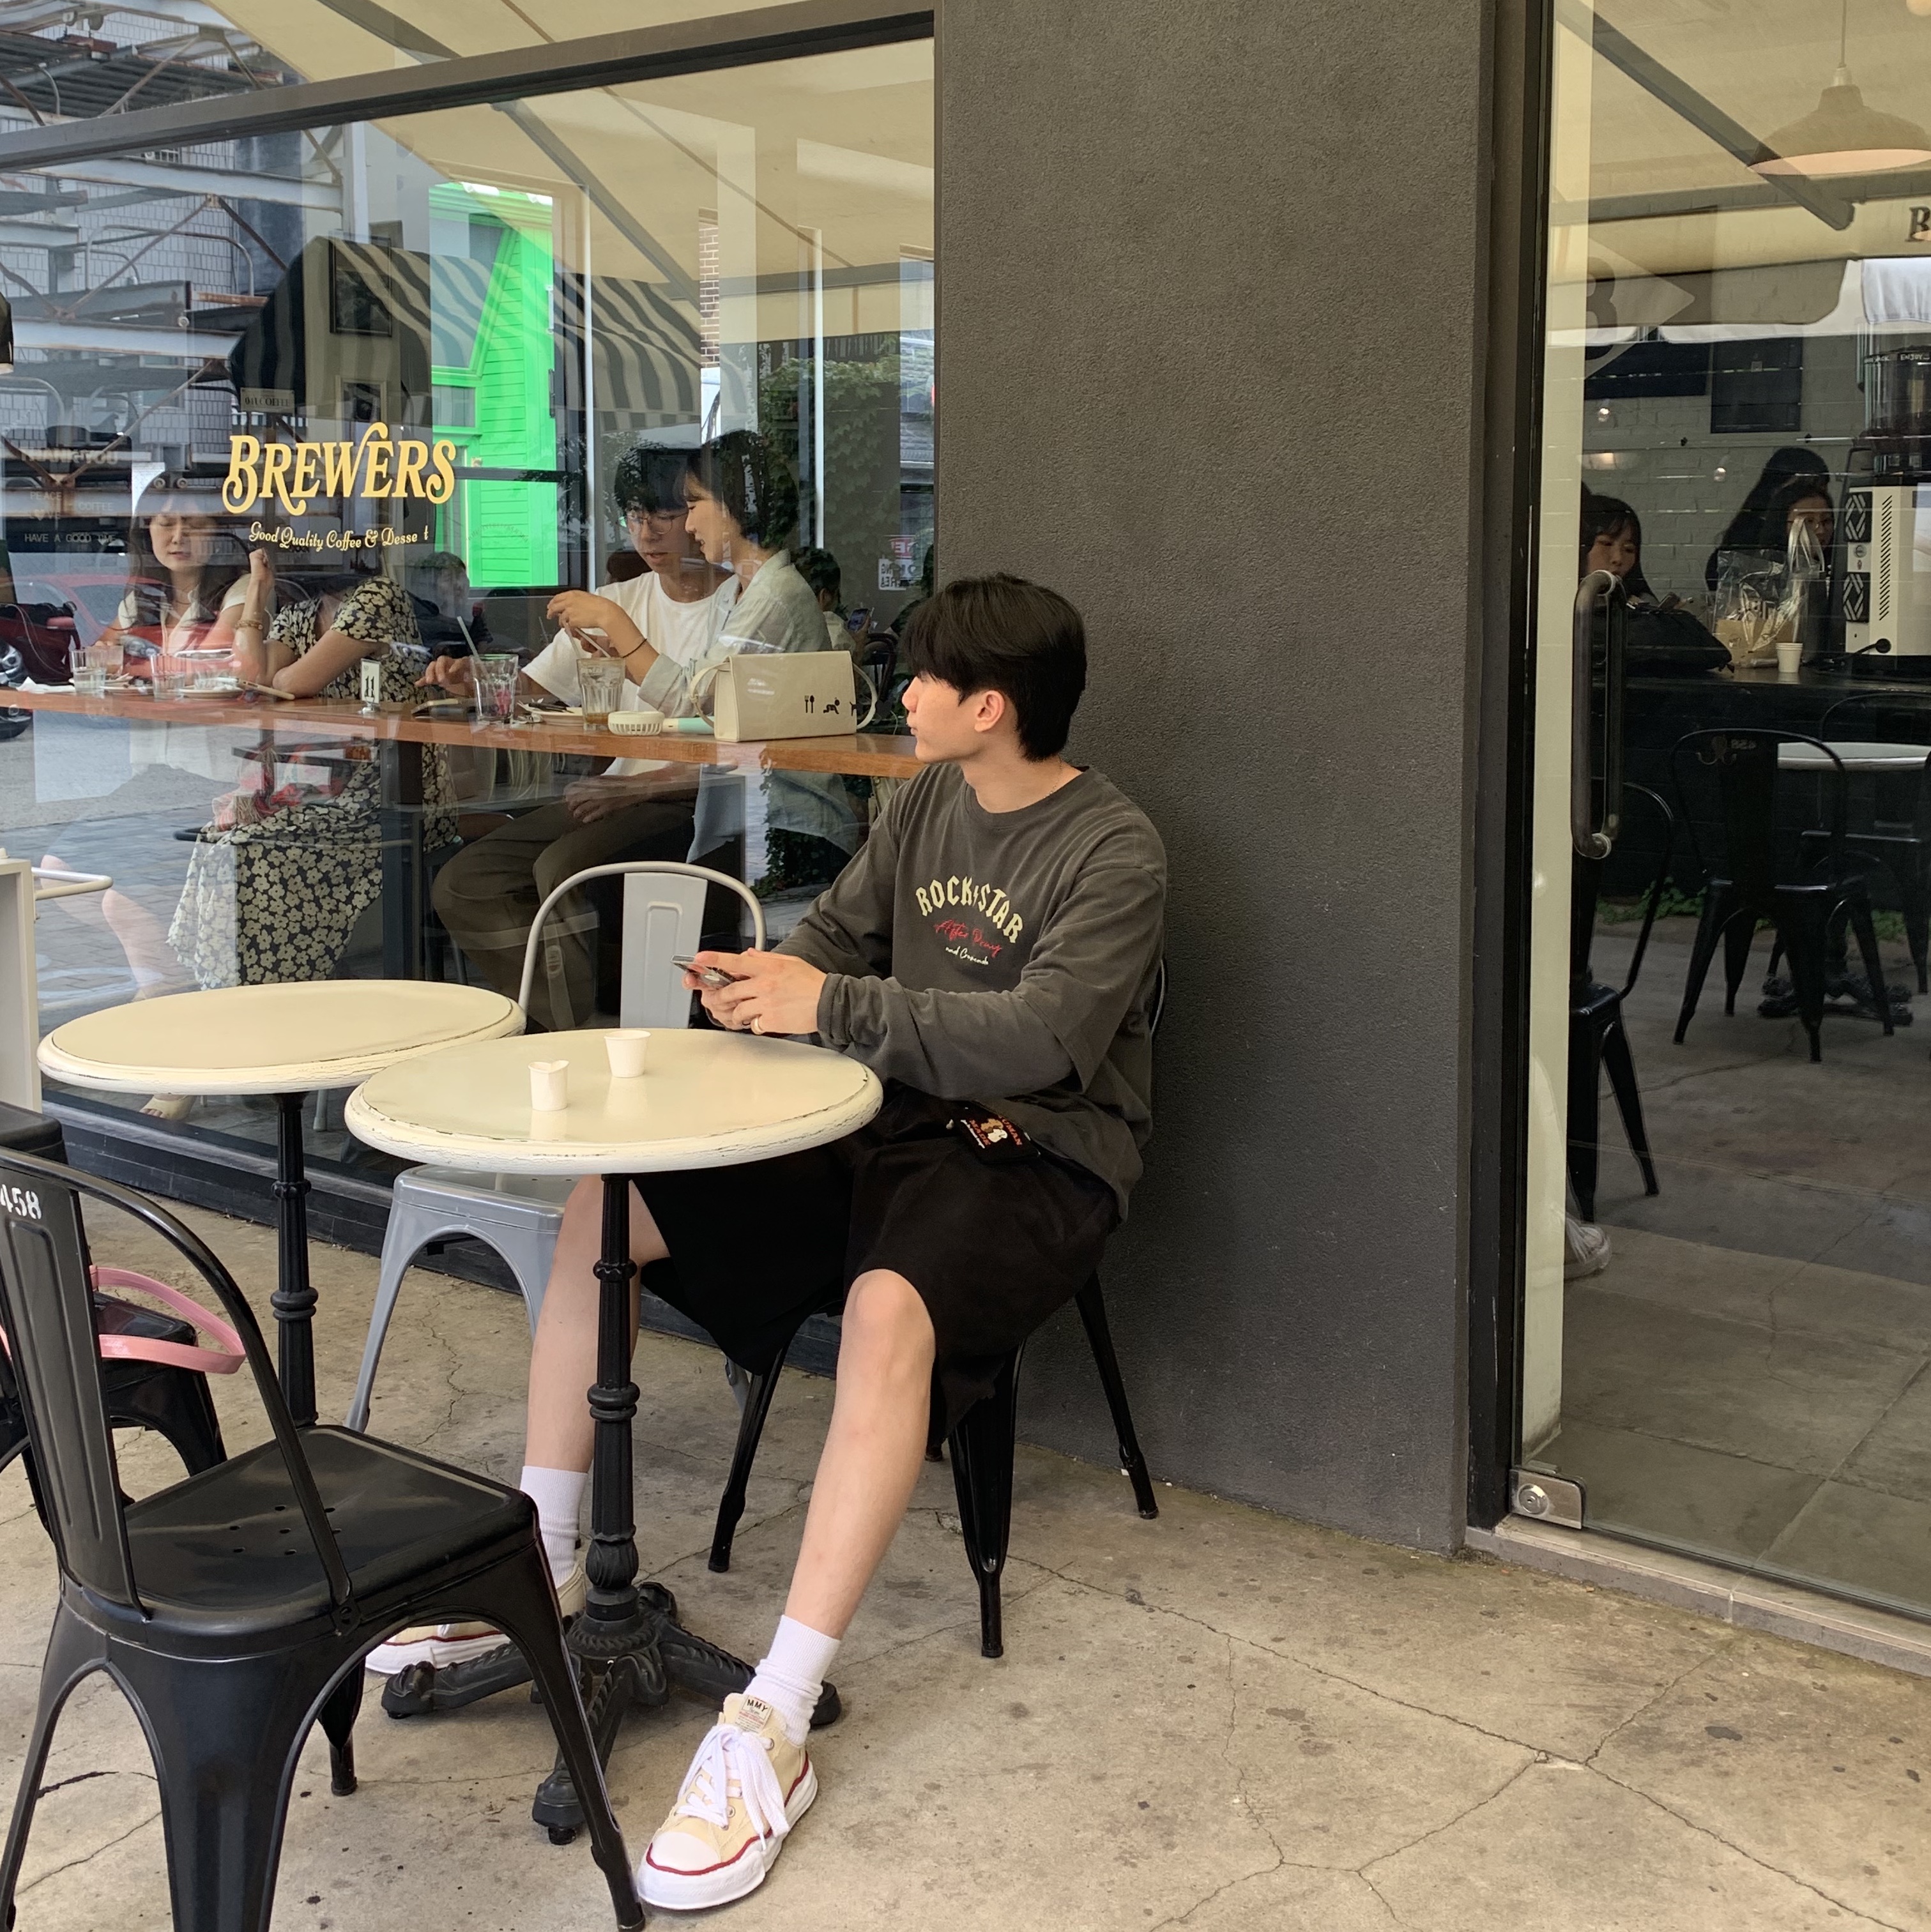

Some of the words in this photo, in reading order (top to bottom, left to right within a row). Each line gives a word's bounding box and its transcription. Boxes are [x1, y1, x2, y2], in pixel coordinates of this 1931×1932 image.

[222, 422, 457, 515] BREWERS
[24, 533, 49, 542] HAVE
[54, 533, 61, 542] A
[65, 533, 91, 542] GOOD
[248, 521, 280, 542] Good
[279, 527, 324, 552] Quality
[326, 530, 362, 551] Coffee
[364, 529, 378, 547] &
[365, 676, 375, 697] 11
[998, 1116, 1022, 1146] UMAN
